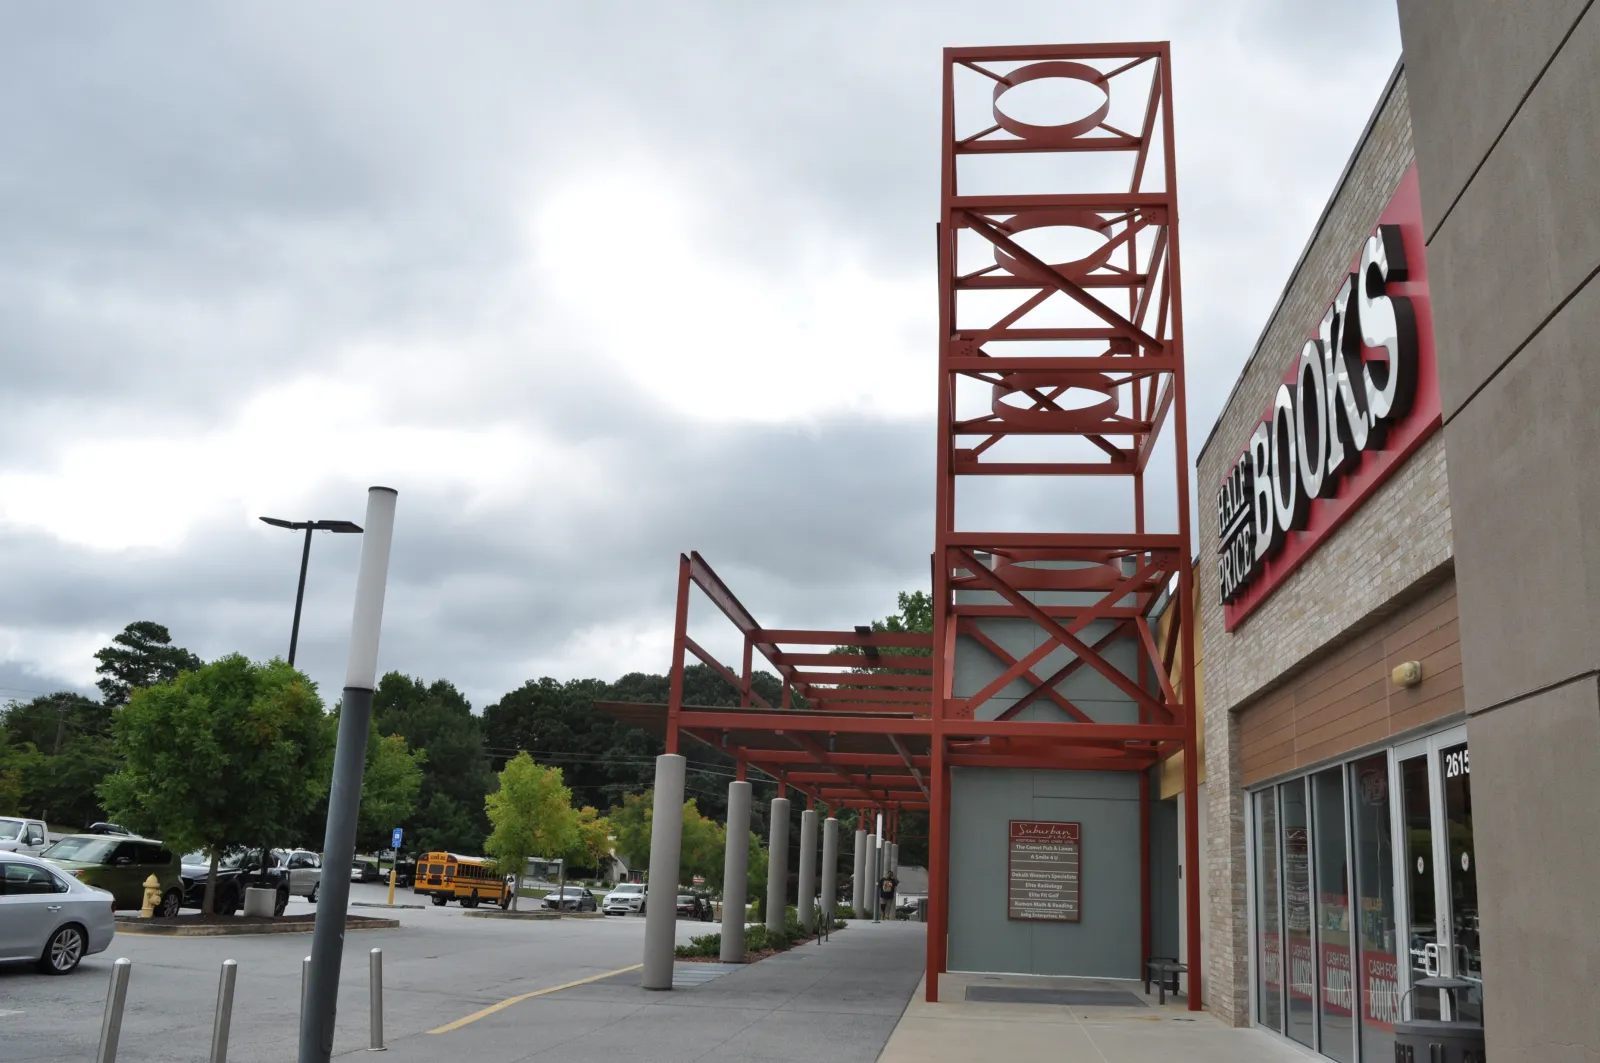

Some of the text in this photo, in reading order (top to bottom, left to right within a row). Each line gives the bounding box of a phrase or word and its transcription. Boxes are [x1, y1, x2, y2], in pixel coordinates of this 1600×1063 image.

[1249, 226, 1404, 563] BOOKS
[1217, 450, 1248, 538] HALF
[1217, 522, 1251, 606] PRICE
[1446, 750, 1470, 778] 2615
[1019, 824, 1071, 836] Suburban
[1326, 950, 1350, 968] CASH FOR
[1368, 959, 1398, 979] CASH FOR
[1327, 966, 1352, 1010] MOVIES
[1369, 976, 1400, 1025] BOOKS
